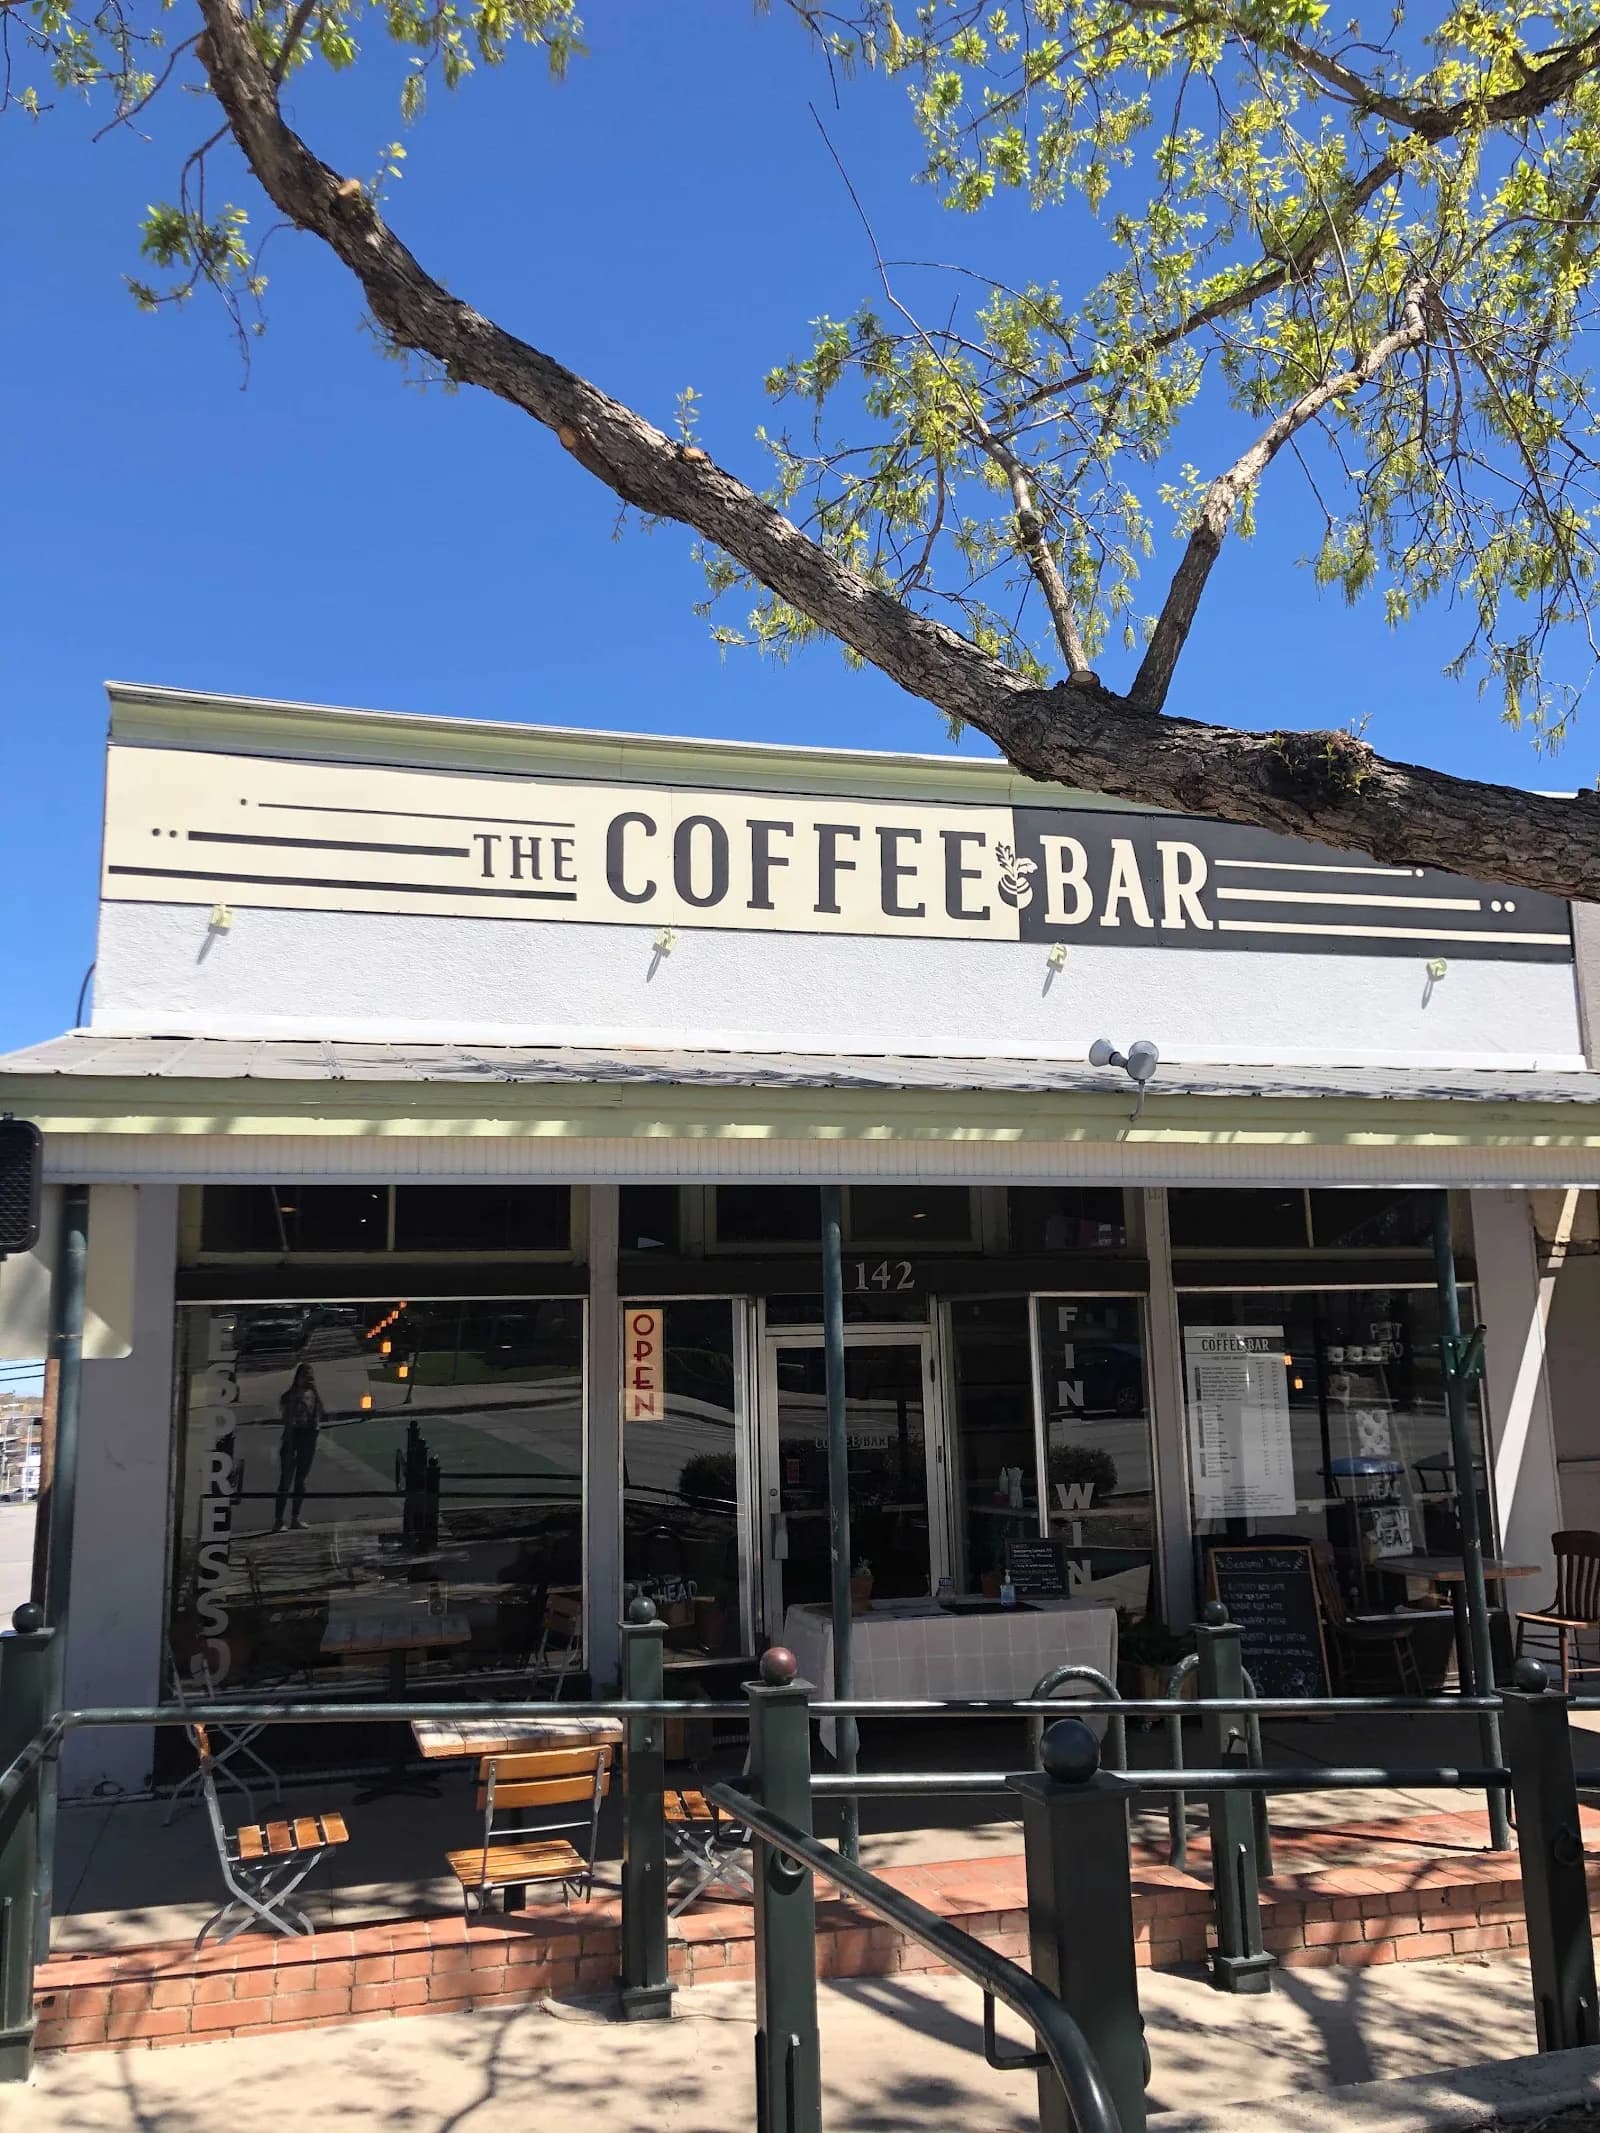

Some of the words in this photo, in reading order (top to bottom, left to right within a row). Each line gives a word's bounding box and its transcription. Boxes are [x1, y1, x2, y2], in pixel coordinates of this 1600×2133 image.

[473, 833, 578, 883] THE
[606, 811, 992, 921] COFFEE
[1039, 834, 1214, 931] BAR
[855, 1259, 915, 1290] 142
[632, 1313, 655, 1417] OPEN
[1201, 1338, 1243, 1351] COFFEE
[1246, 1338, 1270, 1351] BAR
[190, 1318, 239, 1687] ESPRESSO
